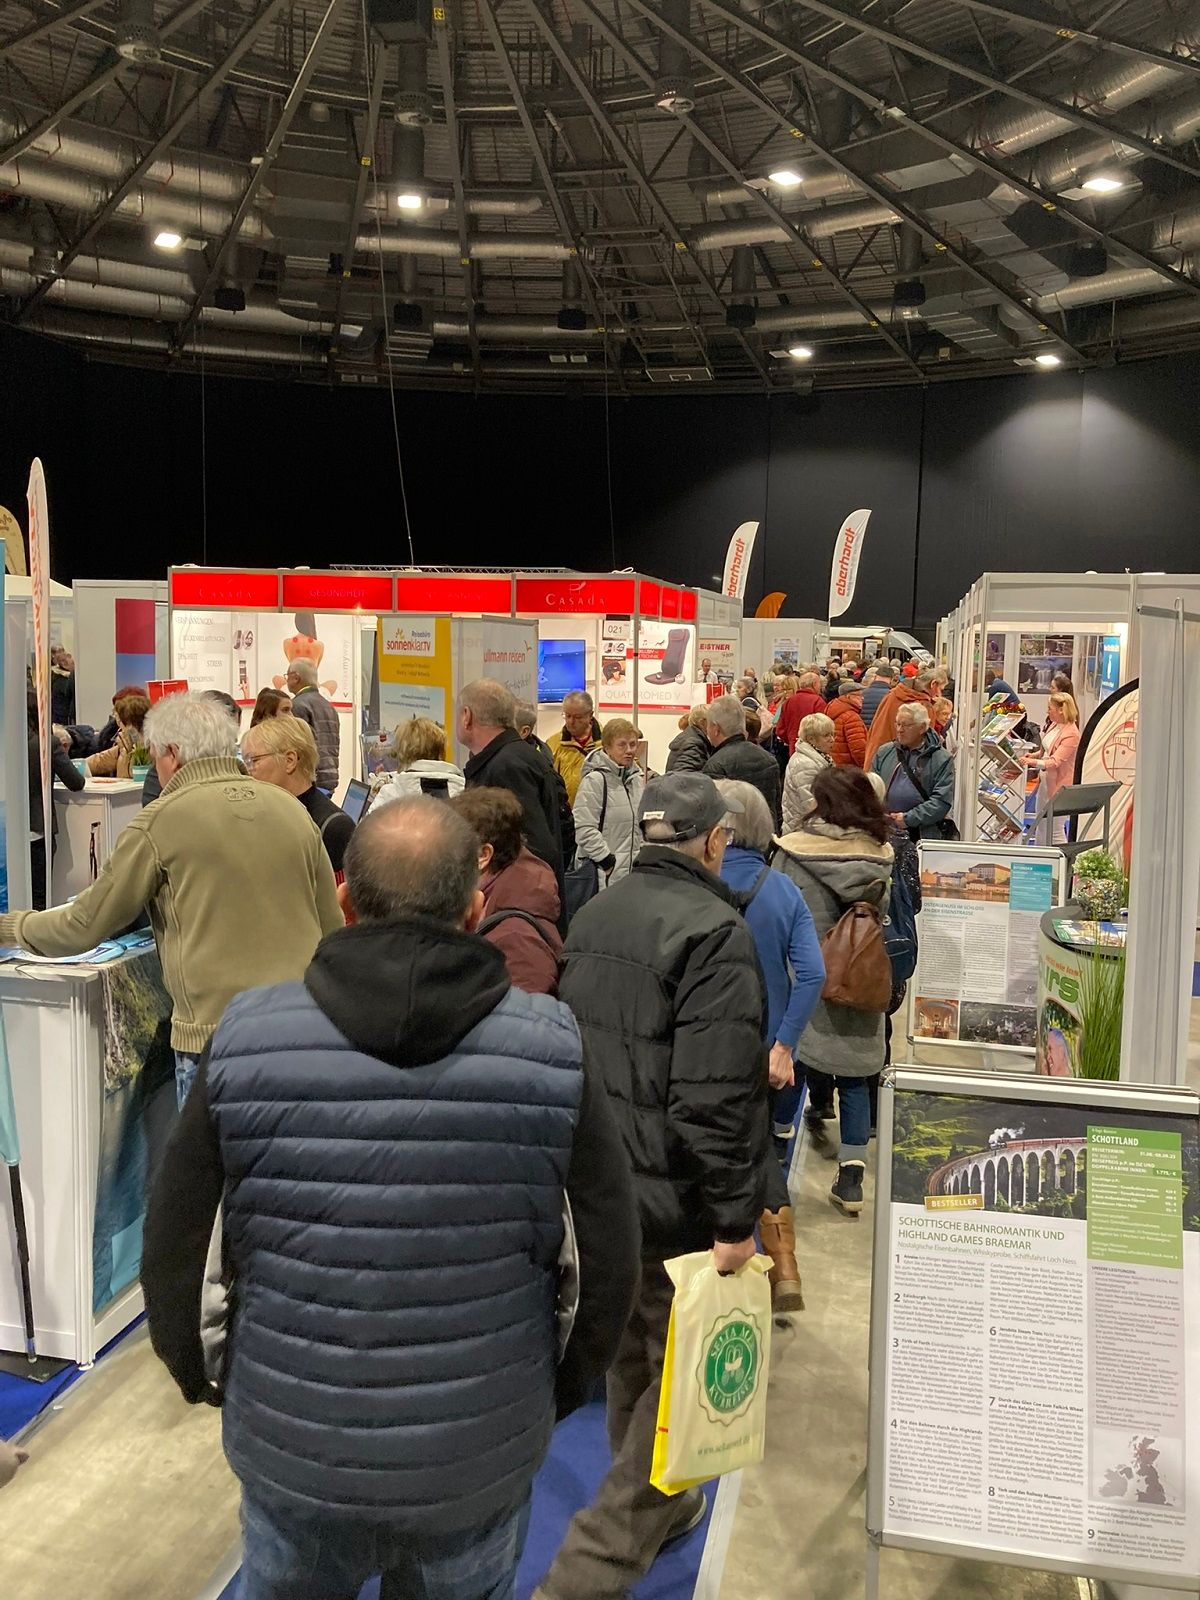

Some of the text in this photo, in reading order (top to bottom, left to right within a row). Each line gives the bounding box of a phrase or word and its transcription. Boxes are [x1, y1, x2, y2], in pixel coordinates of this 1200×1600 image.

[836, 527, 856, 597] eberhardt
[1091, 1134, 1139, 1146] SCHOTTLAND
[931, 1198, 978, 1208] BESTSELLER
[898, 1216, 1065, 1241] SCHOTTISCHE BAHNROMANTIK UND
[898, 1229, 1032, 1250] HIGHLAND GAMES BRAEMAR
[897, 1241, 933, 1251] Nostalgische
[895, 1254, 900, 1263] 1
[894, 1293, 901, 1303] 2
[989, 1326, 997, 1336] 6
[892, 1337, 899, 1348] 3
[989, 1396, 996, 1406] 7
[890, 1418, 898, 1429] 4
[988, 1486, 996, 1497] 8
[888, 1495, 895, 1507] 5
[1087, 1528, 1095, 1539] 9
